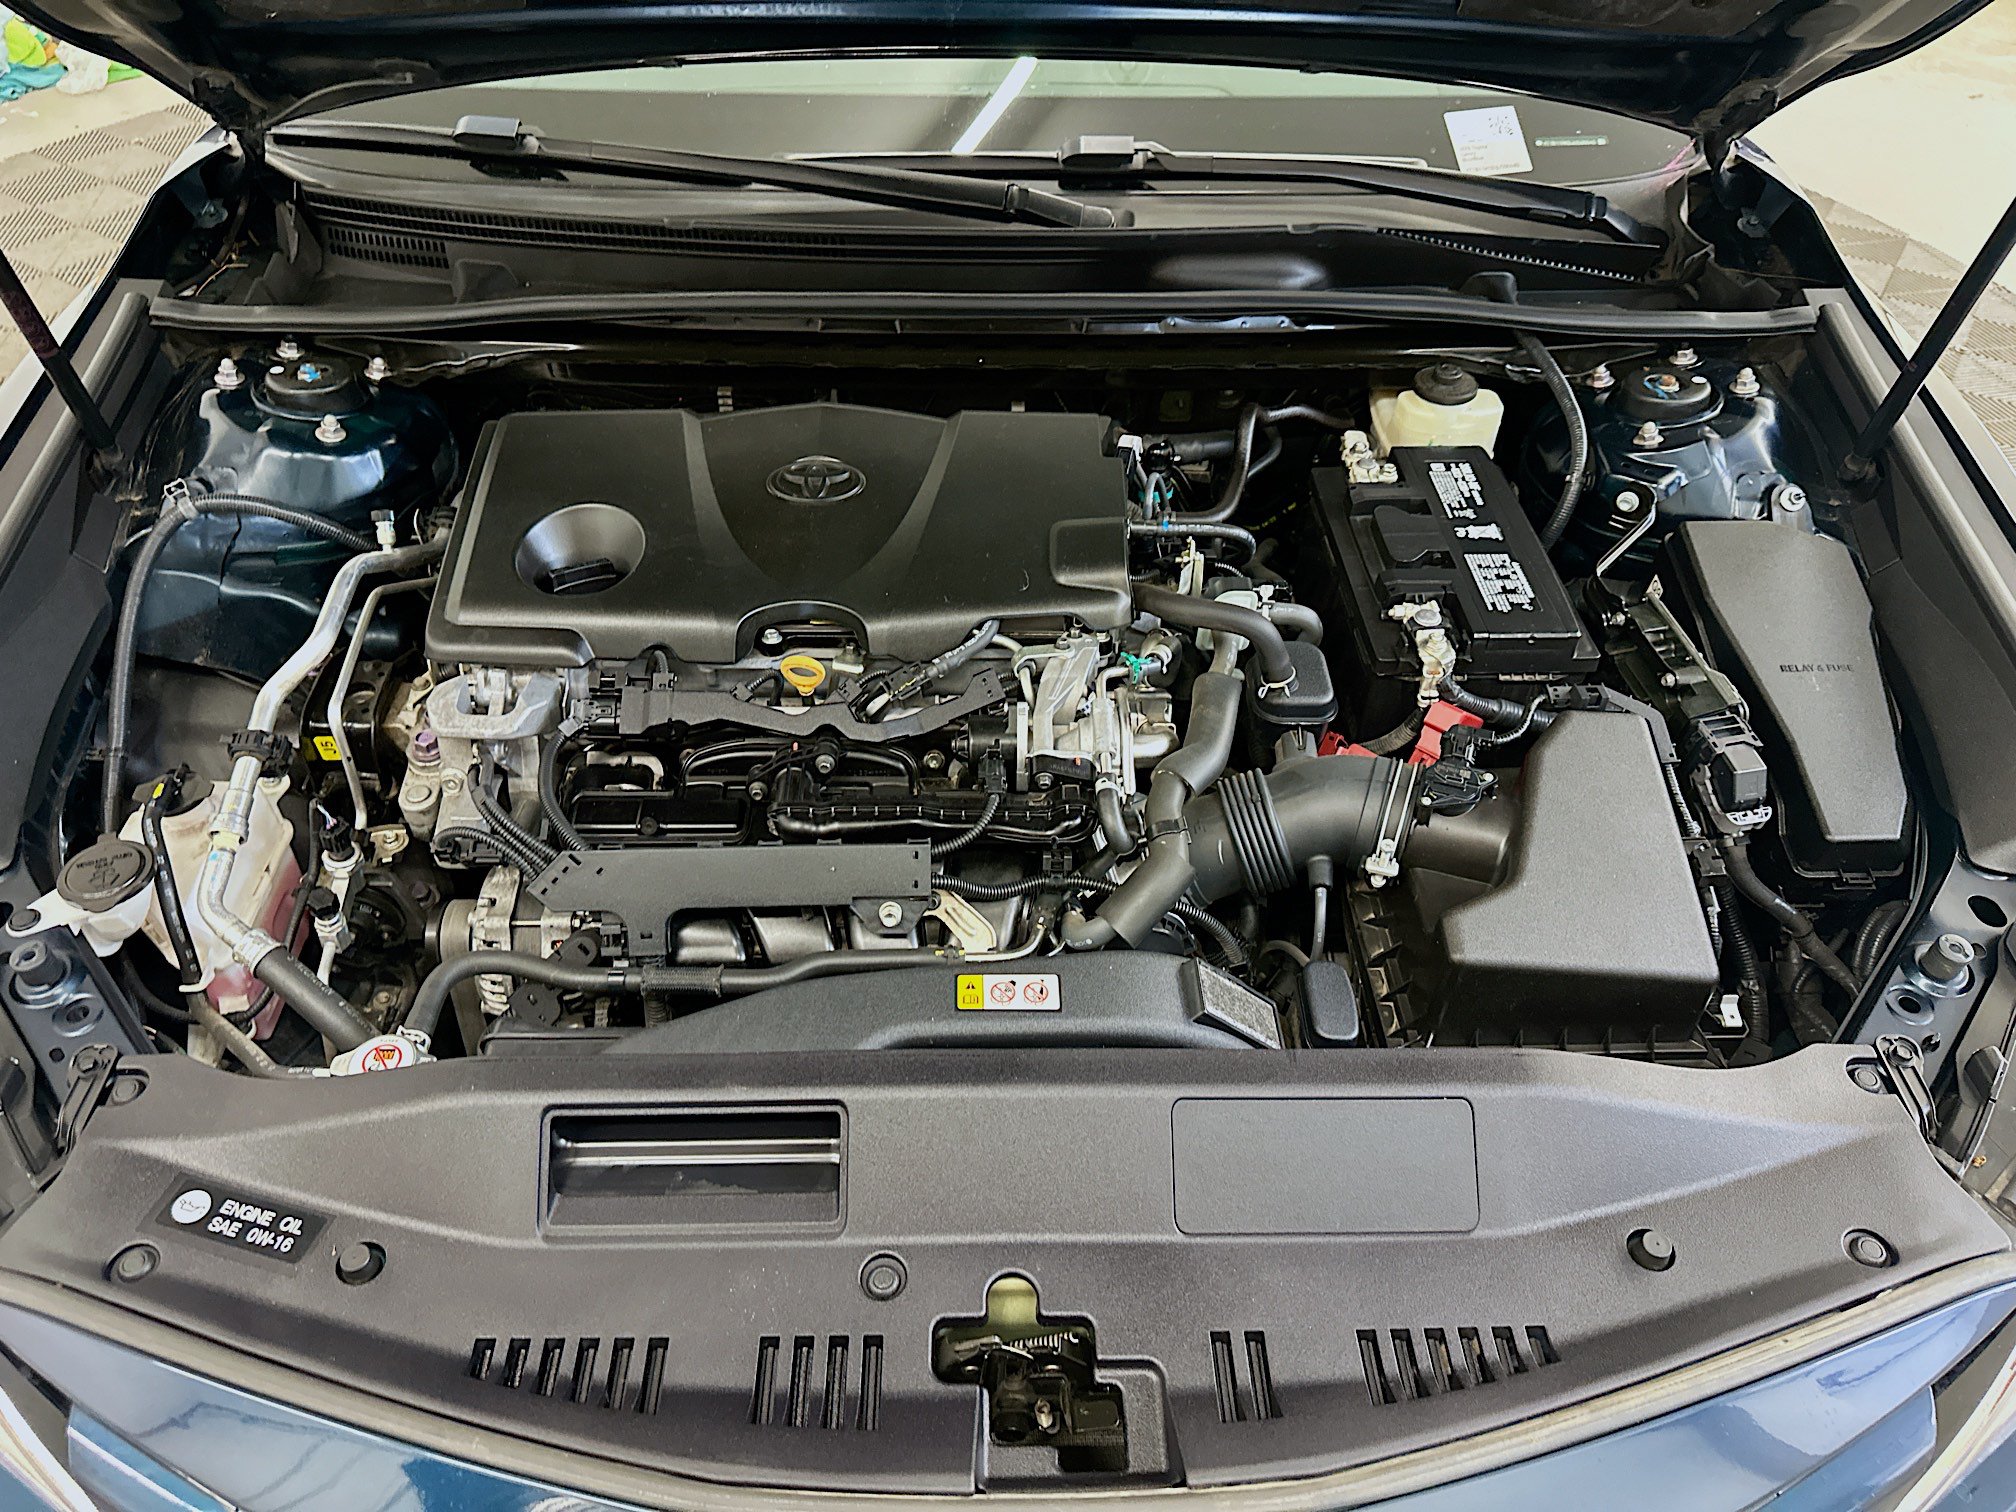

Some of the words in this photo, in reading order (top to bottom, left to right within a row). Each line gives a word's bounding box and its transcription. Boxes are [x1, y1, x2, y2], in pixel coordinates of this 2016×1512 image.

[1779, 664, 1814, 673] RELAY
[1825, 663, 1855, 673] FUSE
[207, 1216, 243, 1238] SAE
[245, 1228, 295, 1253] 0W-16
[219, 1199, 277, 1227] ENGINE
[279, 1216, 304, 1236] OIL
